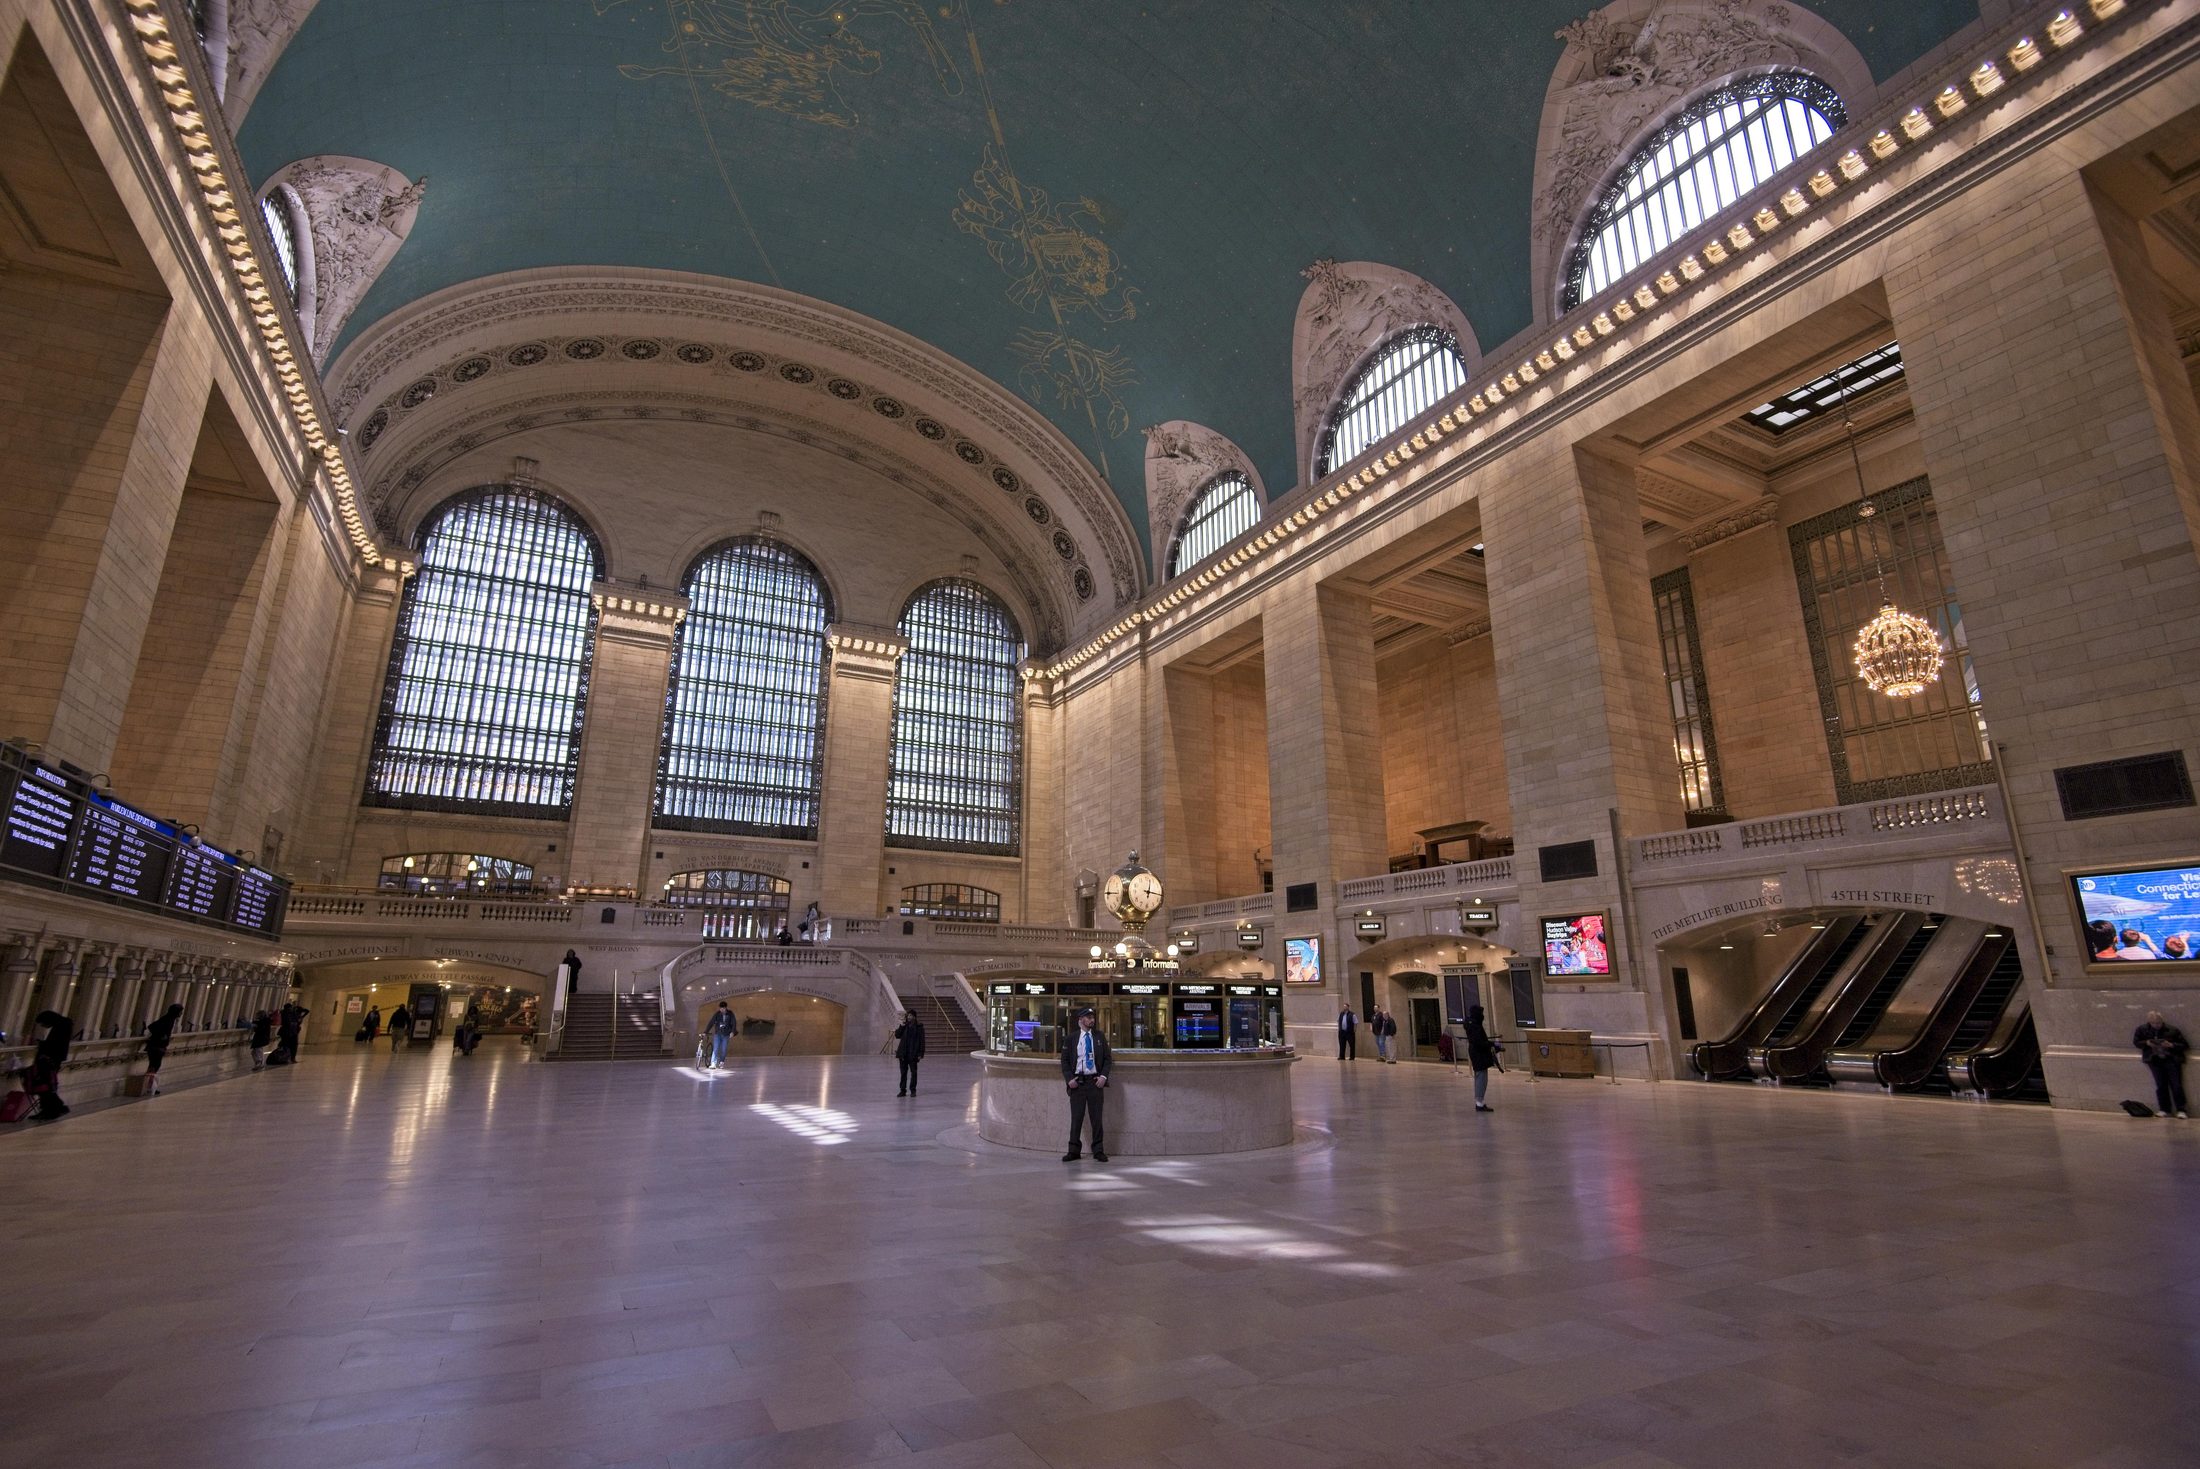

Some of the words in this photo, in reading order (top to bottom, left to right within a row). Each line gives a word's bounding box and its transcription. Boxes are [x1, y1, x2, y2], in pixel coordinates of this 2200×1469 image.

[701, 855, 749, 863] VANDERBILT
[1831, 890, 1868, 901] 45TH
[1873, 891, 1935, 905] STREET
[2162, 892, 2181, 900] for
[1651, 924, 1674, 939] THE
[1674, 906, 1722, 929] METLIFE
[1723, 894, 1783, 914] BUILDING
[297, 949, 332, 961] ICKET
[337, 945, 399, 957] MACHINES
[608, 945, 640, 953] BALCONY
[434, 947, 474, 958] SUBWAY
[511, 957, 525, 966] ST
[961, 965, 985, 975] TICKET
[988, 962, 1021, 970] MACHINES
[1143, 958, 1179, 969] Information
[383, 973, 418, 982] SUBWAY
